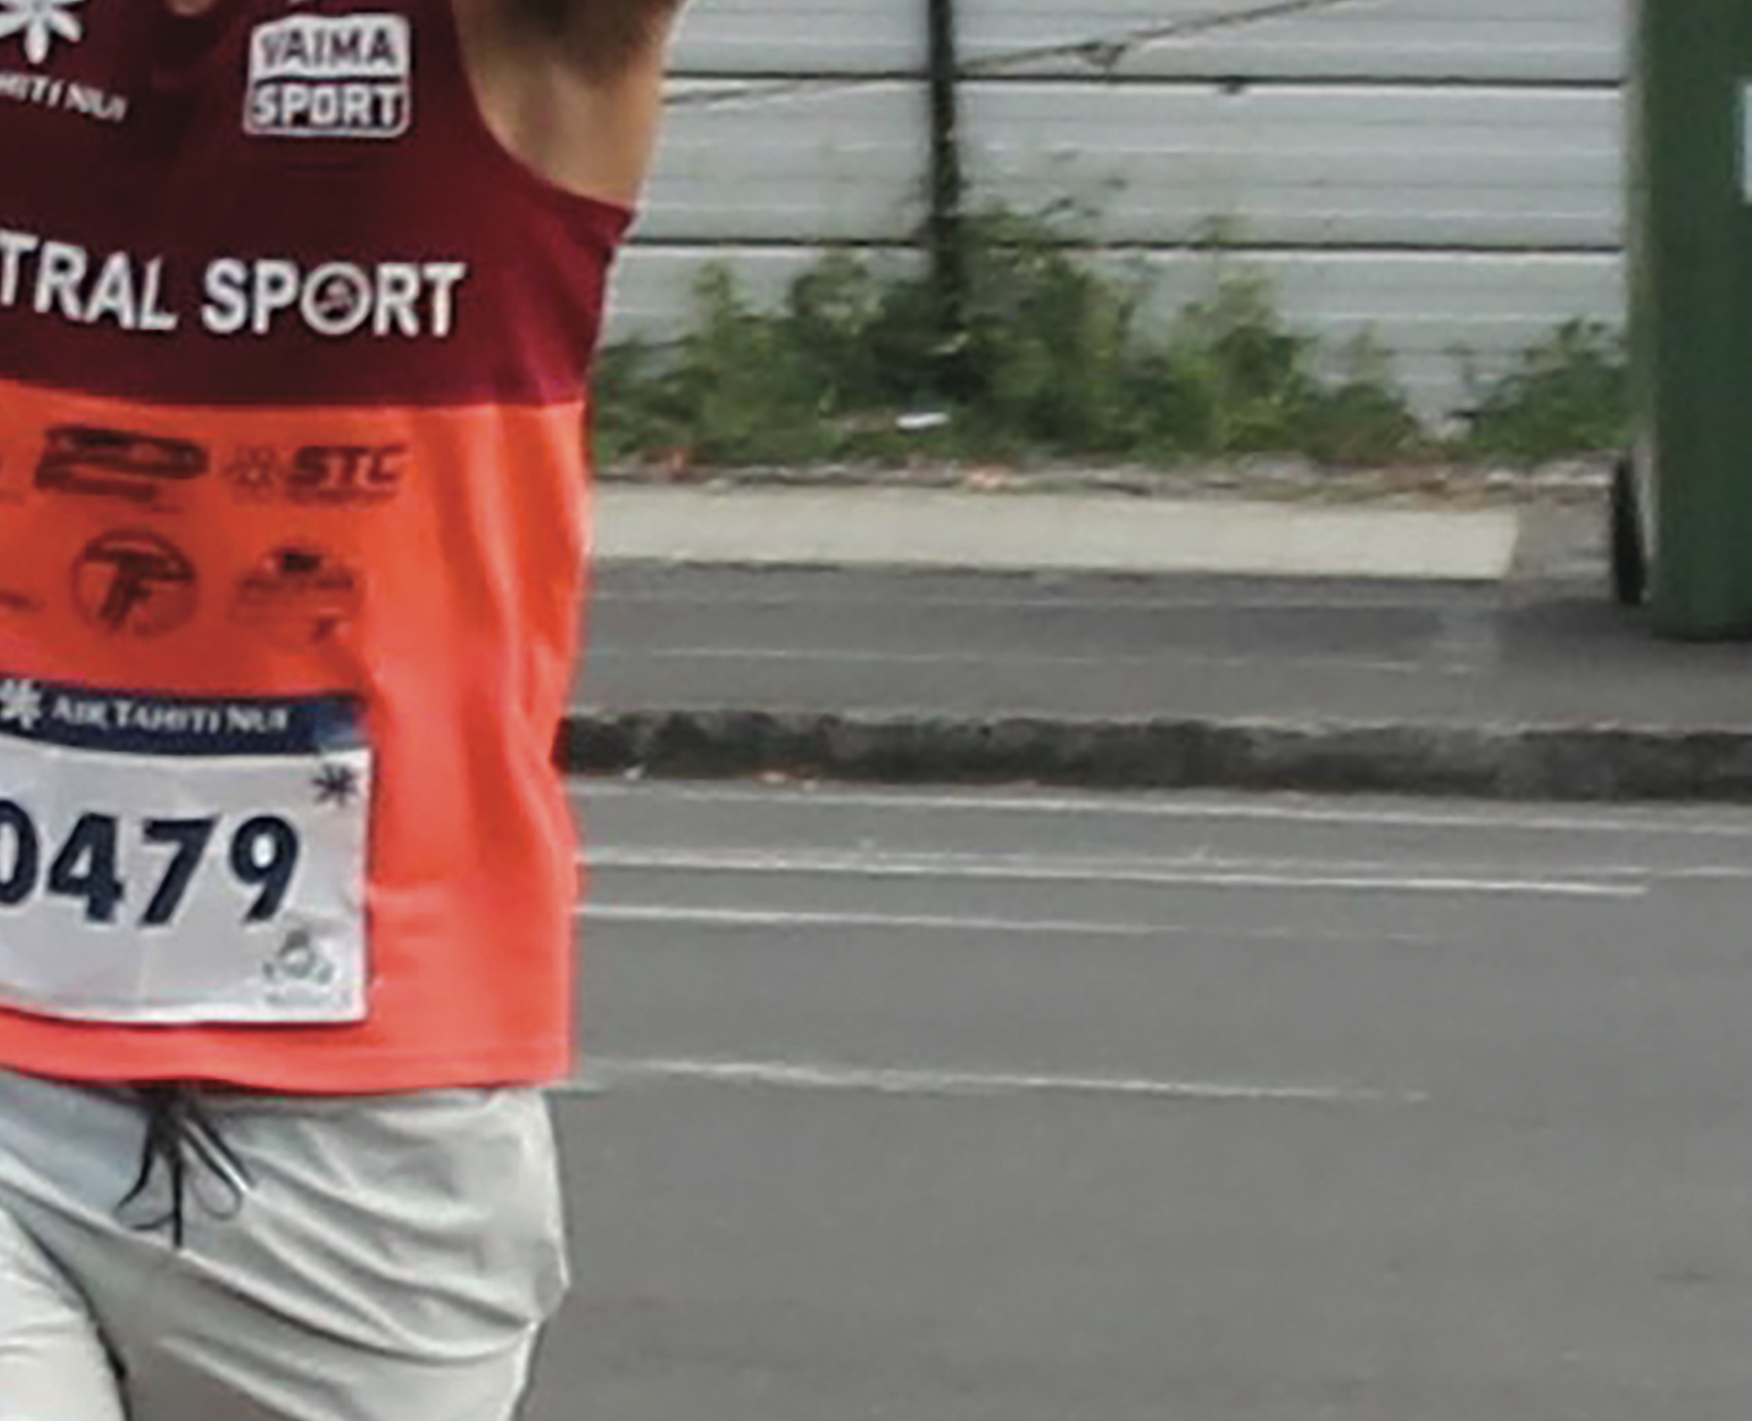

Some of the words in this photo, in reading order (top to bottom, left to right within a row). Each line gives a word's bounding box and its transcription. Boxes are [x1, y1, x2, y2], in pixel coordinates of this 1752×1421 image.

[253, 82, 404, 126] SPORT
[201, 258, 466, 337] SPORT
[114, 699, 220, 735] TAHITI
